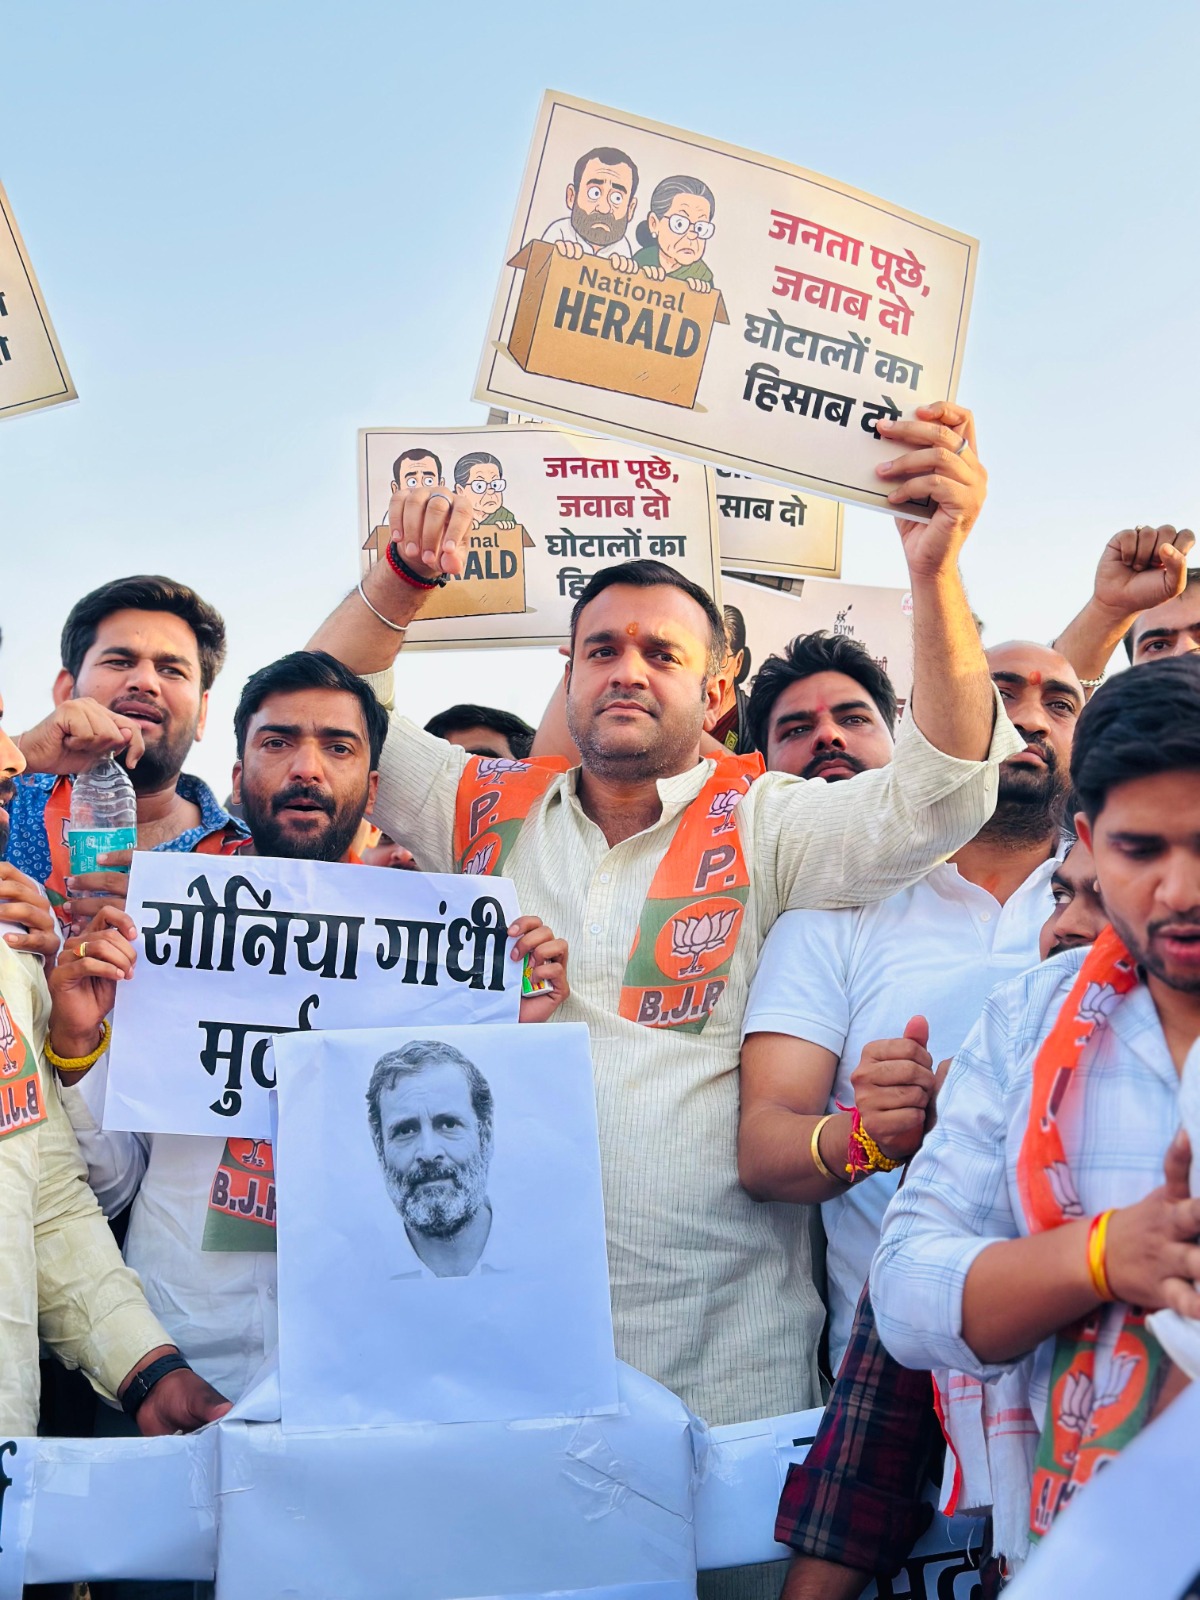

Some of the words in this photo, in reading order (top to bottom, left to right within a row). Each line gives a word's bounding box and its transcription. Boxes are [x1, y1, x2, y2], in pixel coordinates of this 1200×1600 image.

[768, 209, 864, 266] जनता
[870, 247, 930, 298] पूछे,
[578, 265, 685, 313] National
[772, 265, 873, 321] जवाब
[878, 293, 914, 336] दो
[554, 286, 701, 358] HERALD
[743, 308, 871, 374] घोटालों
[874, 350, 923, 391] का
[742, 362, 856, 427] हिसाब
[543, 457, 619, 479] जनता
[624, 455, 679, 489] पूछे,
[557, 496, 635, 518] जवाब
[640, 488, 671, 520] दो
[716, 494, 774, 522] साब
[779, 494, 808, 527] दो
[545, 527, 642, 557] घोटालों
[647, 535, 687, 557] का
[833, 624, 855, 636] BJYM
[141, 874, 365, 980] सोनिया
[375, 896, 508, 991] गांधी
